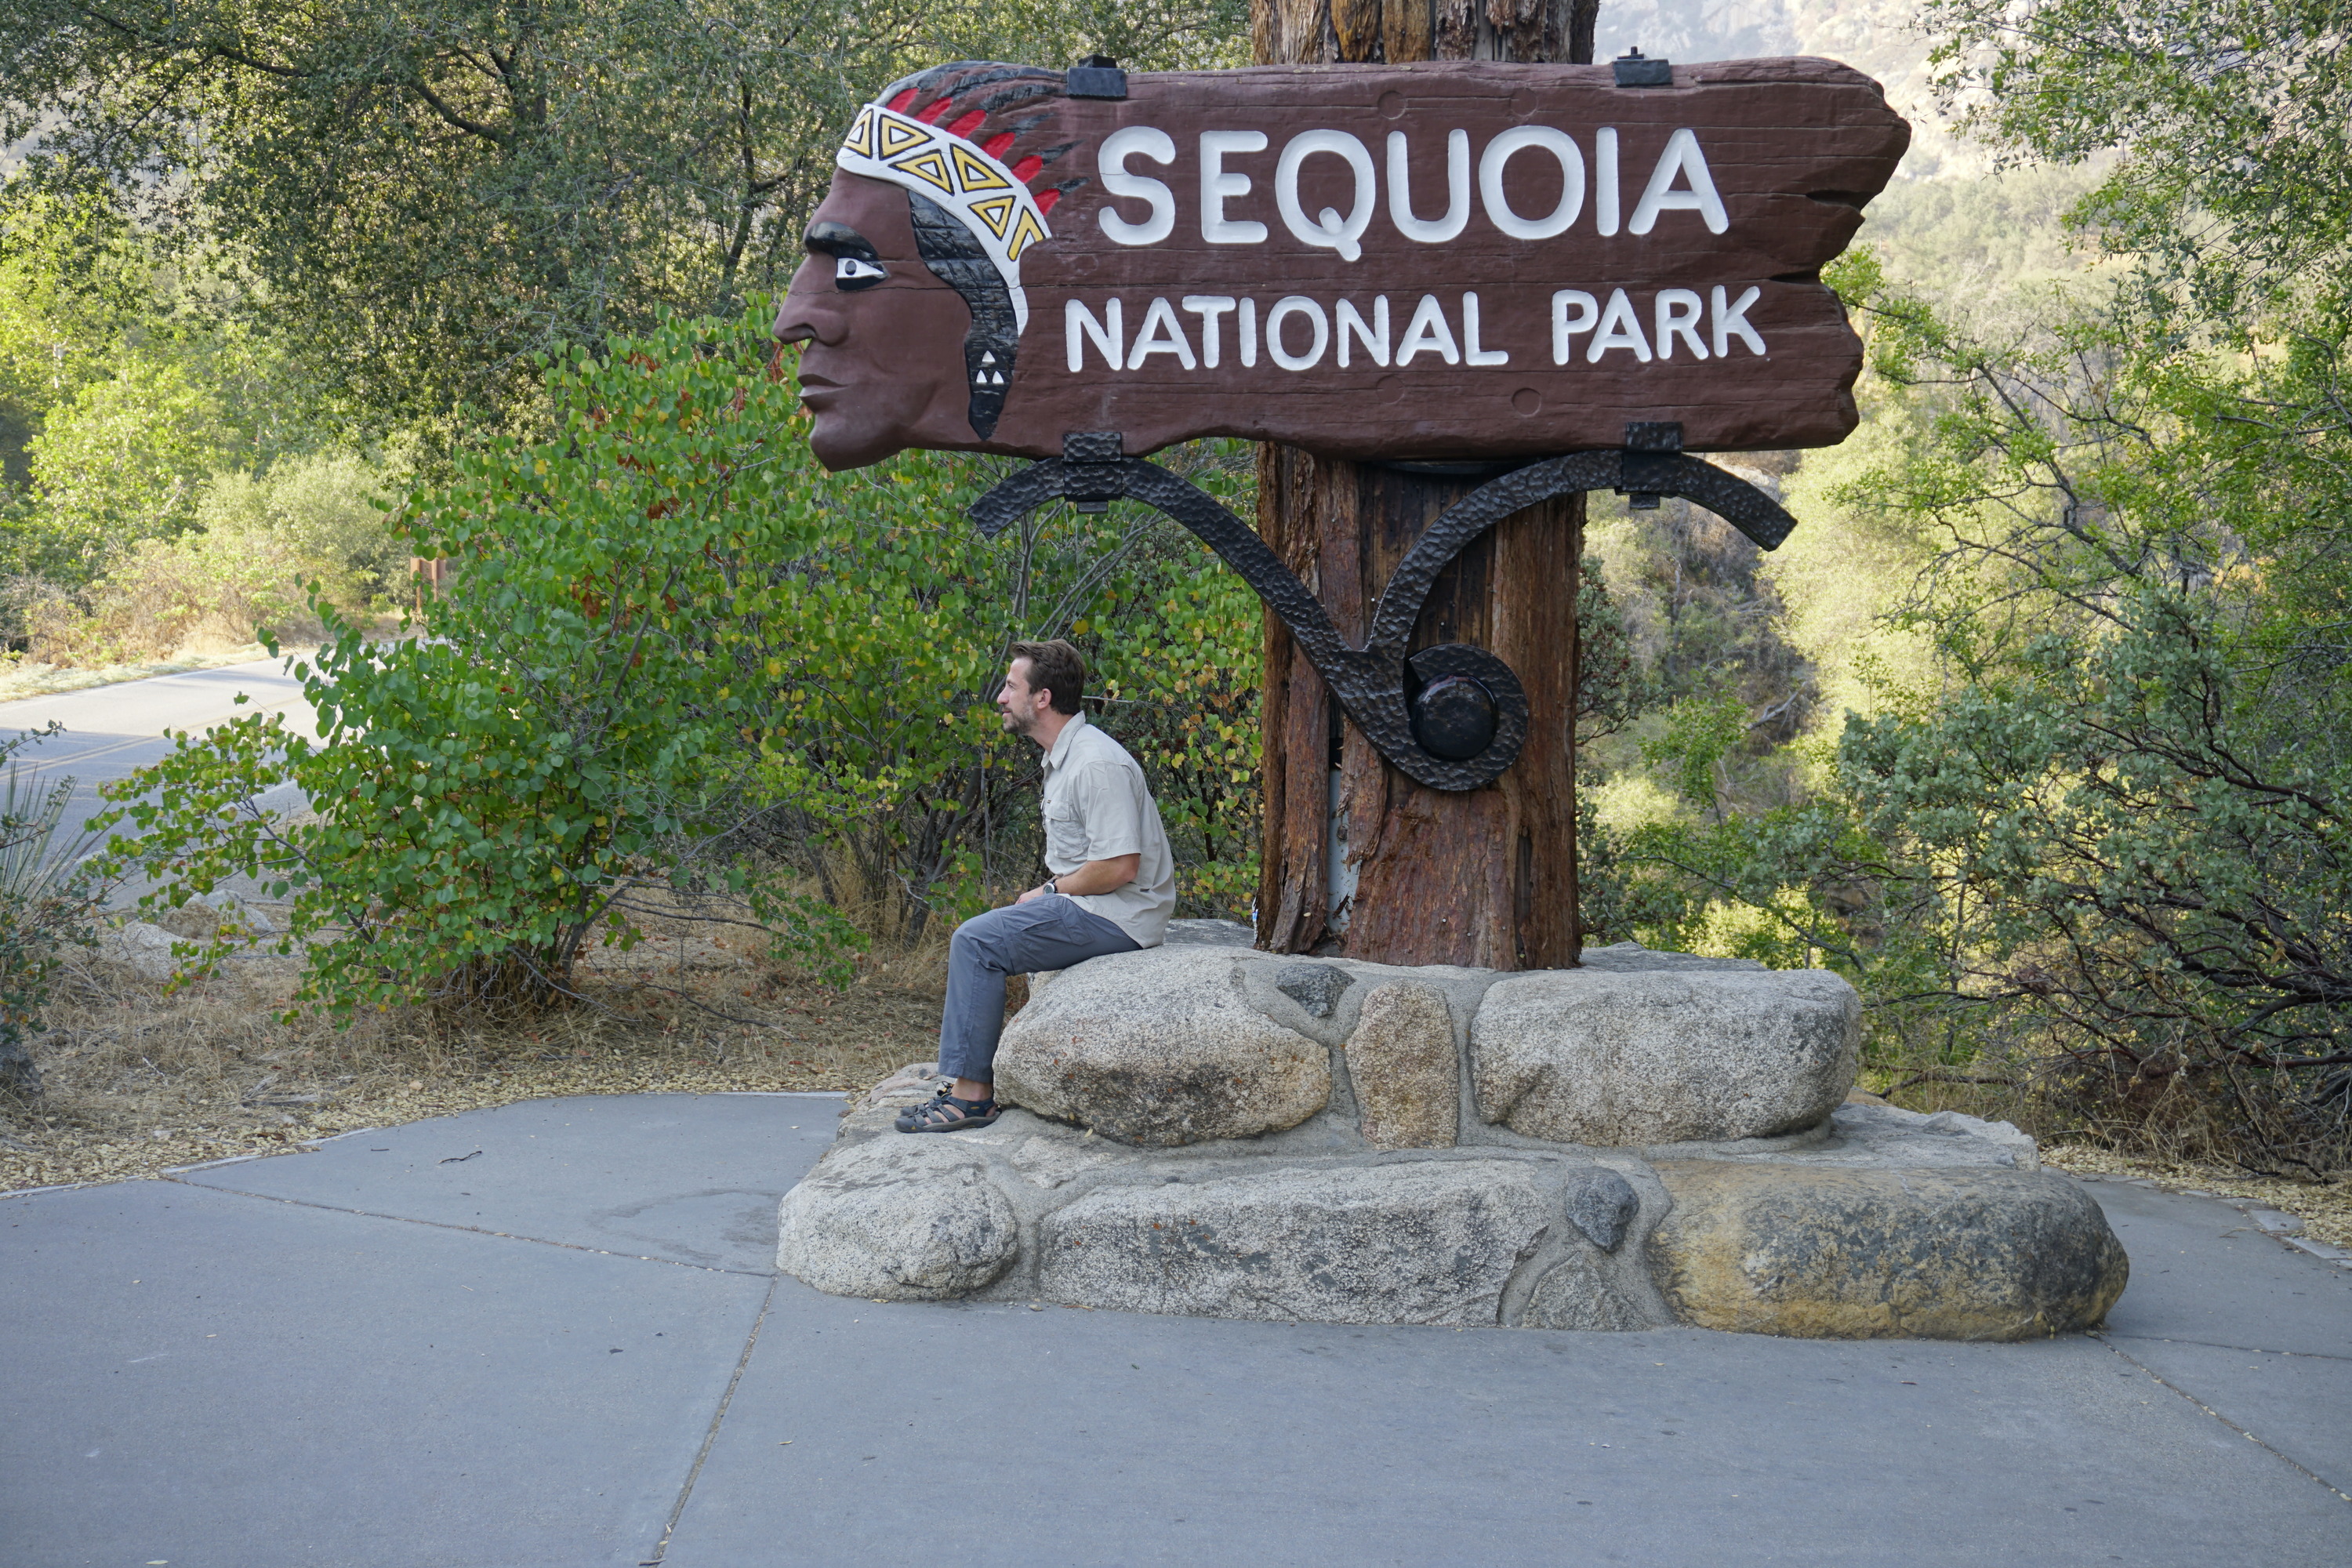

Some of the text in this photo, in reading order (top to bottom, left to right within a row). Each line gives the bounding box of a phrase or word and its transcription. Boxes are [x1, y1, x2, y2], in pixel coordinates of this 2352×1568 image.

[1099, 126, 1729, 261] SEQUOIA
[1065, 286, 1766, 372] NATIONAL PARK
